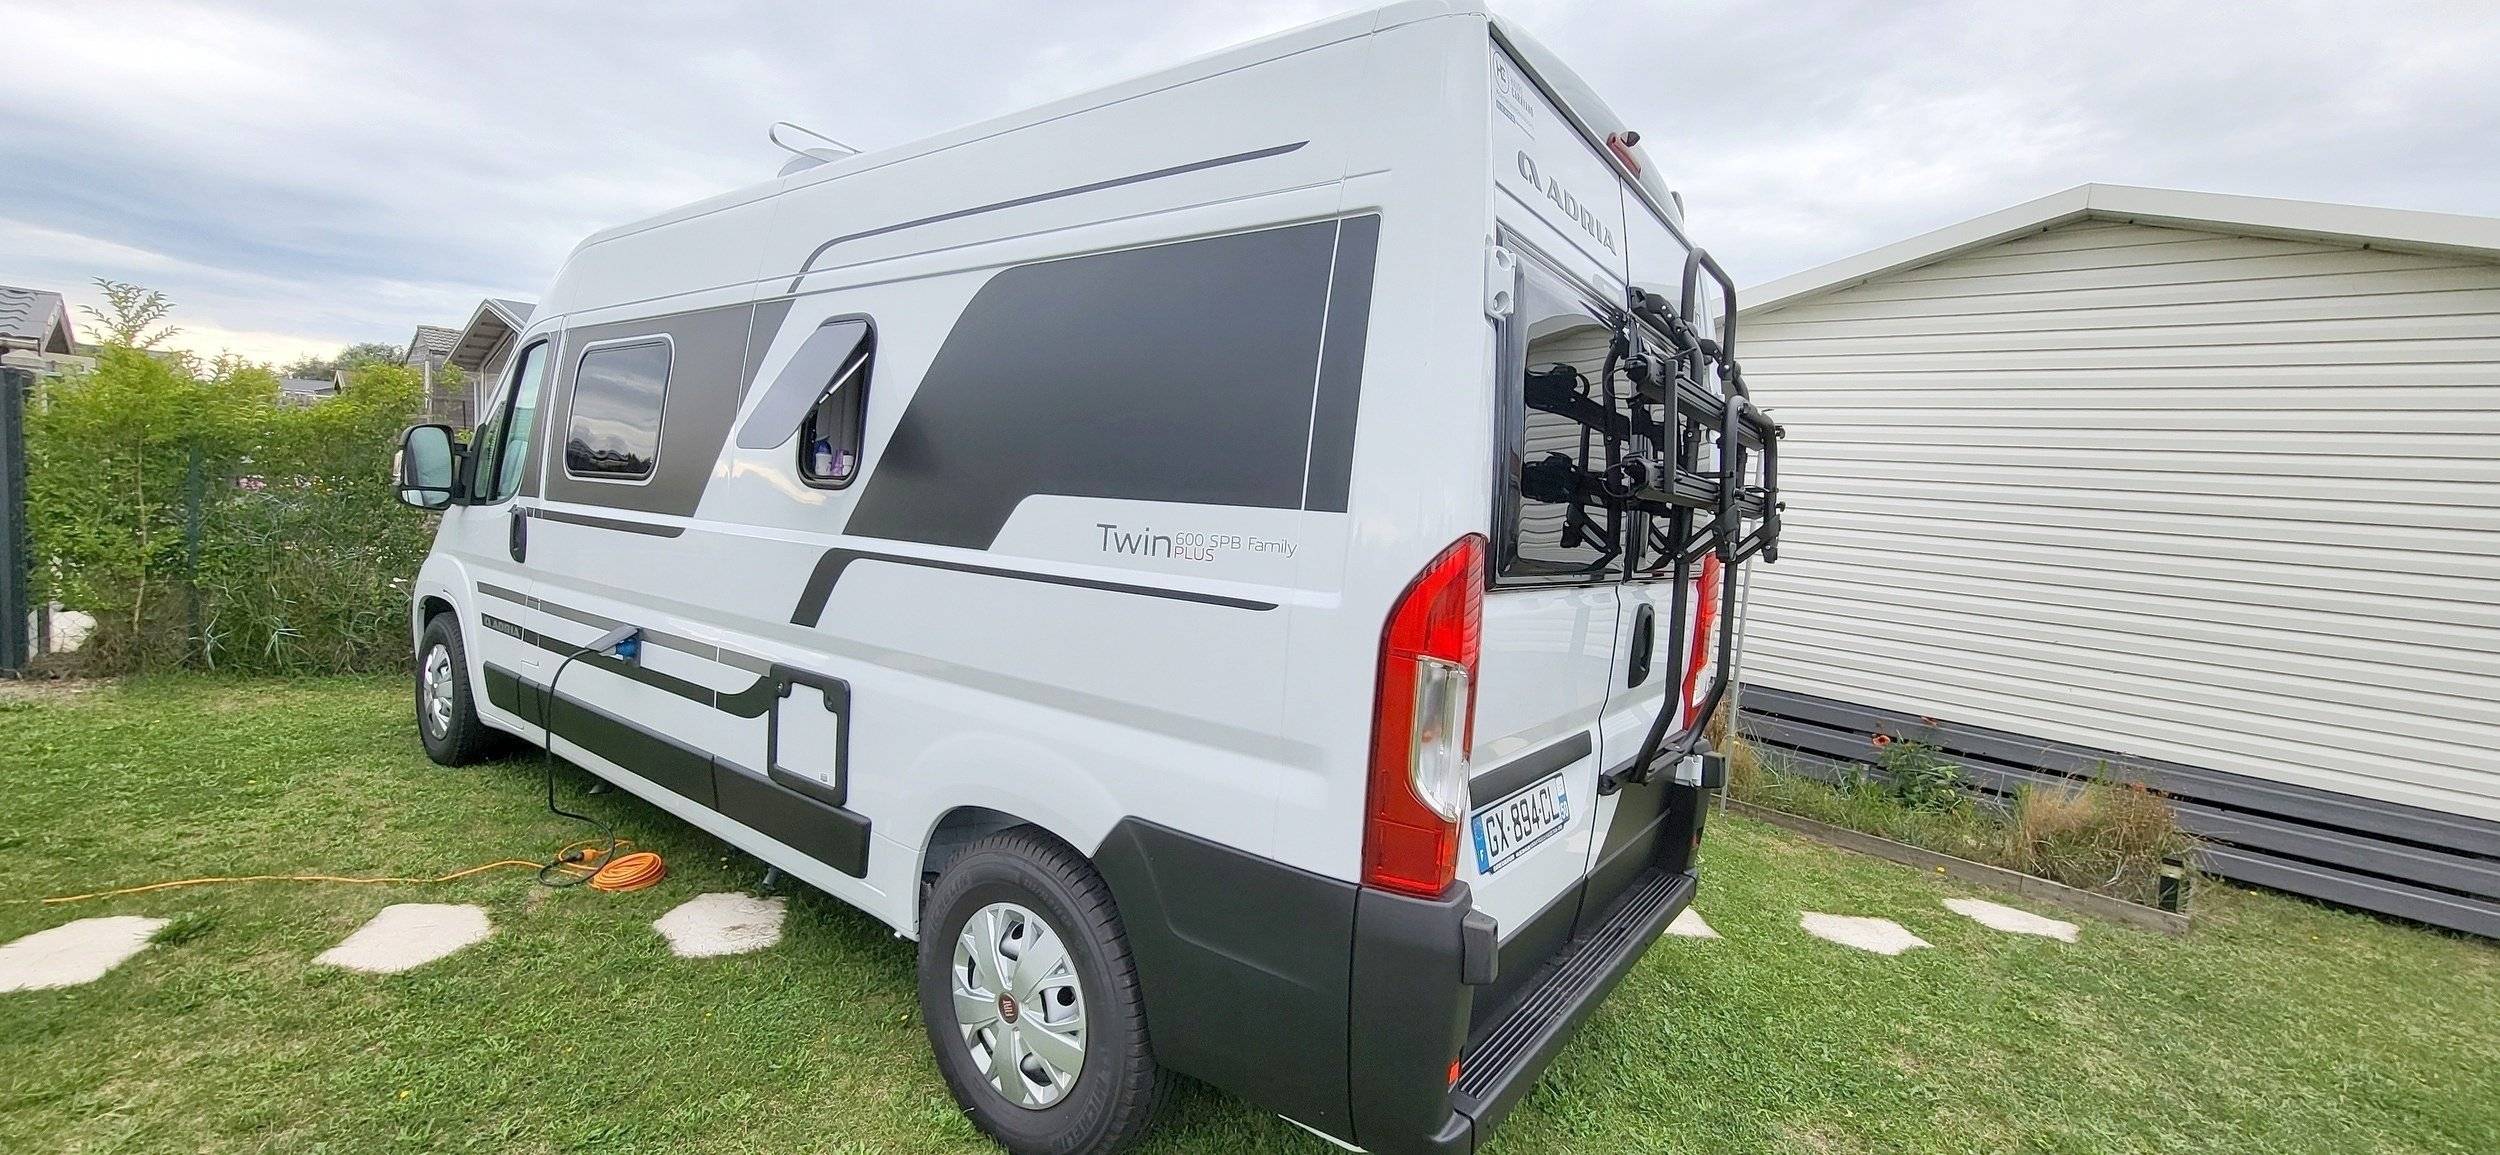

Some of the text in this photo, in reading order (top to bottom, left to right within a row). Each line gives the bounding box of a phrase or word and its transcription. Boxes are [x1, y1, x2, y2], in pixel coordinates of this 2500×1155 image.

[1547, 175, 1617, 256] ADRIA
[1096, 523, 1299, 559] Twin 600 SPB Family
[1174, 546, 1215, 562] PLUS
[492, 619, 520, 638] ADRIA
[1486, 786, 1560, 858] GX-894-CL
[1002, 1000, 1014, 1017] FIAT
